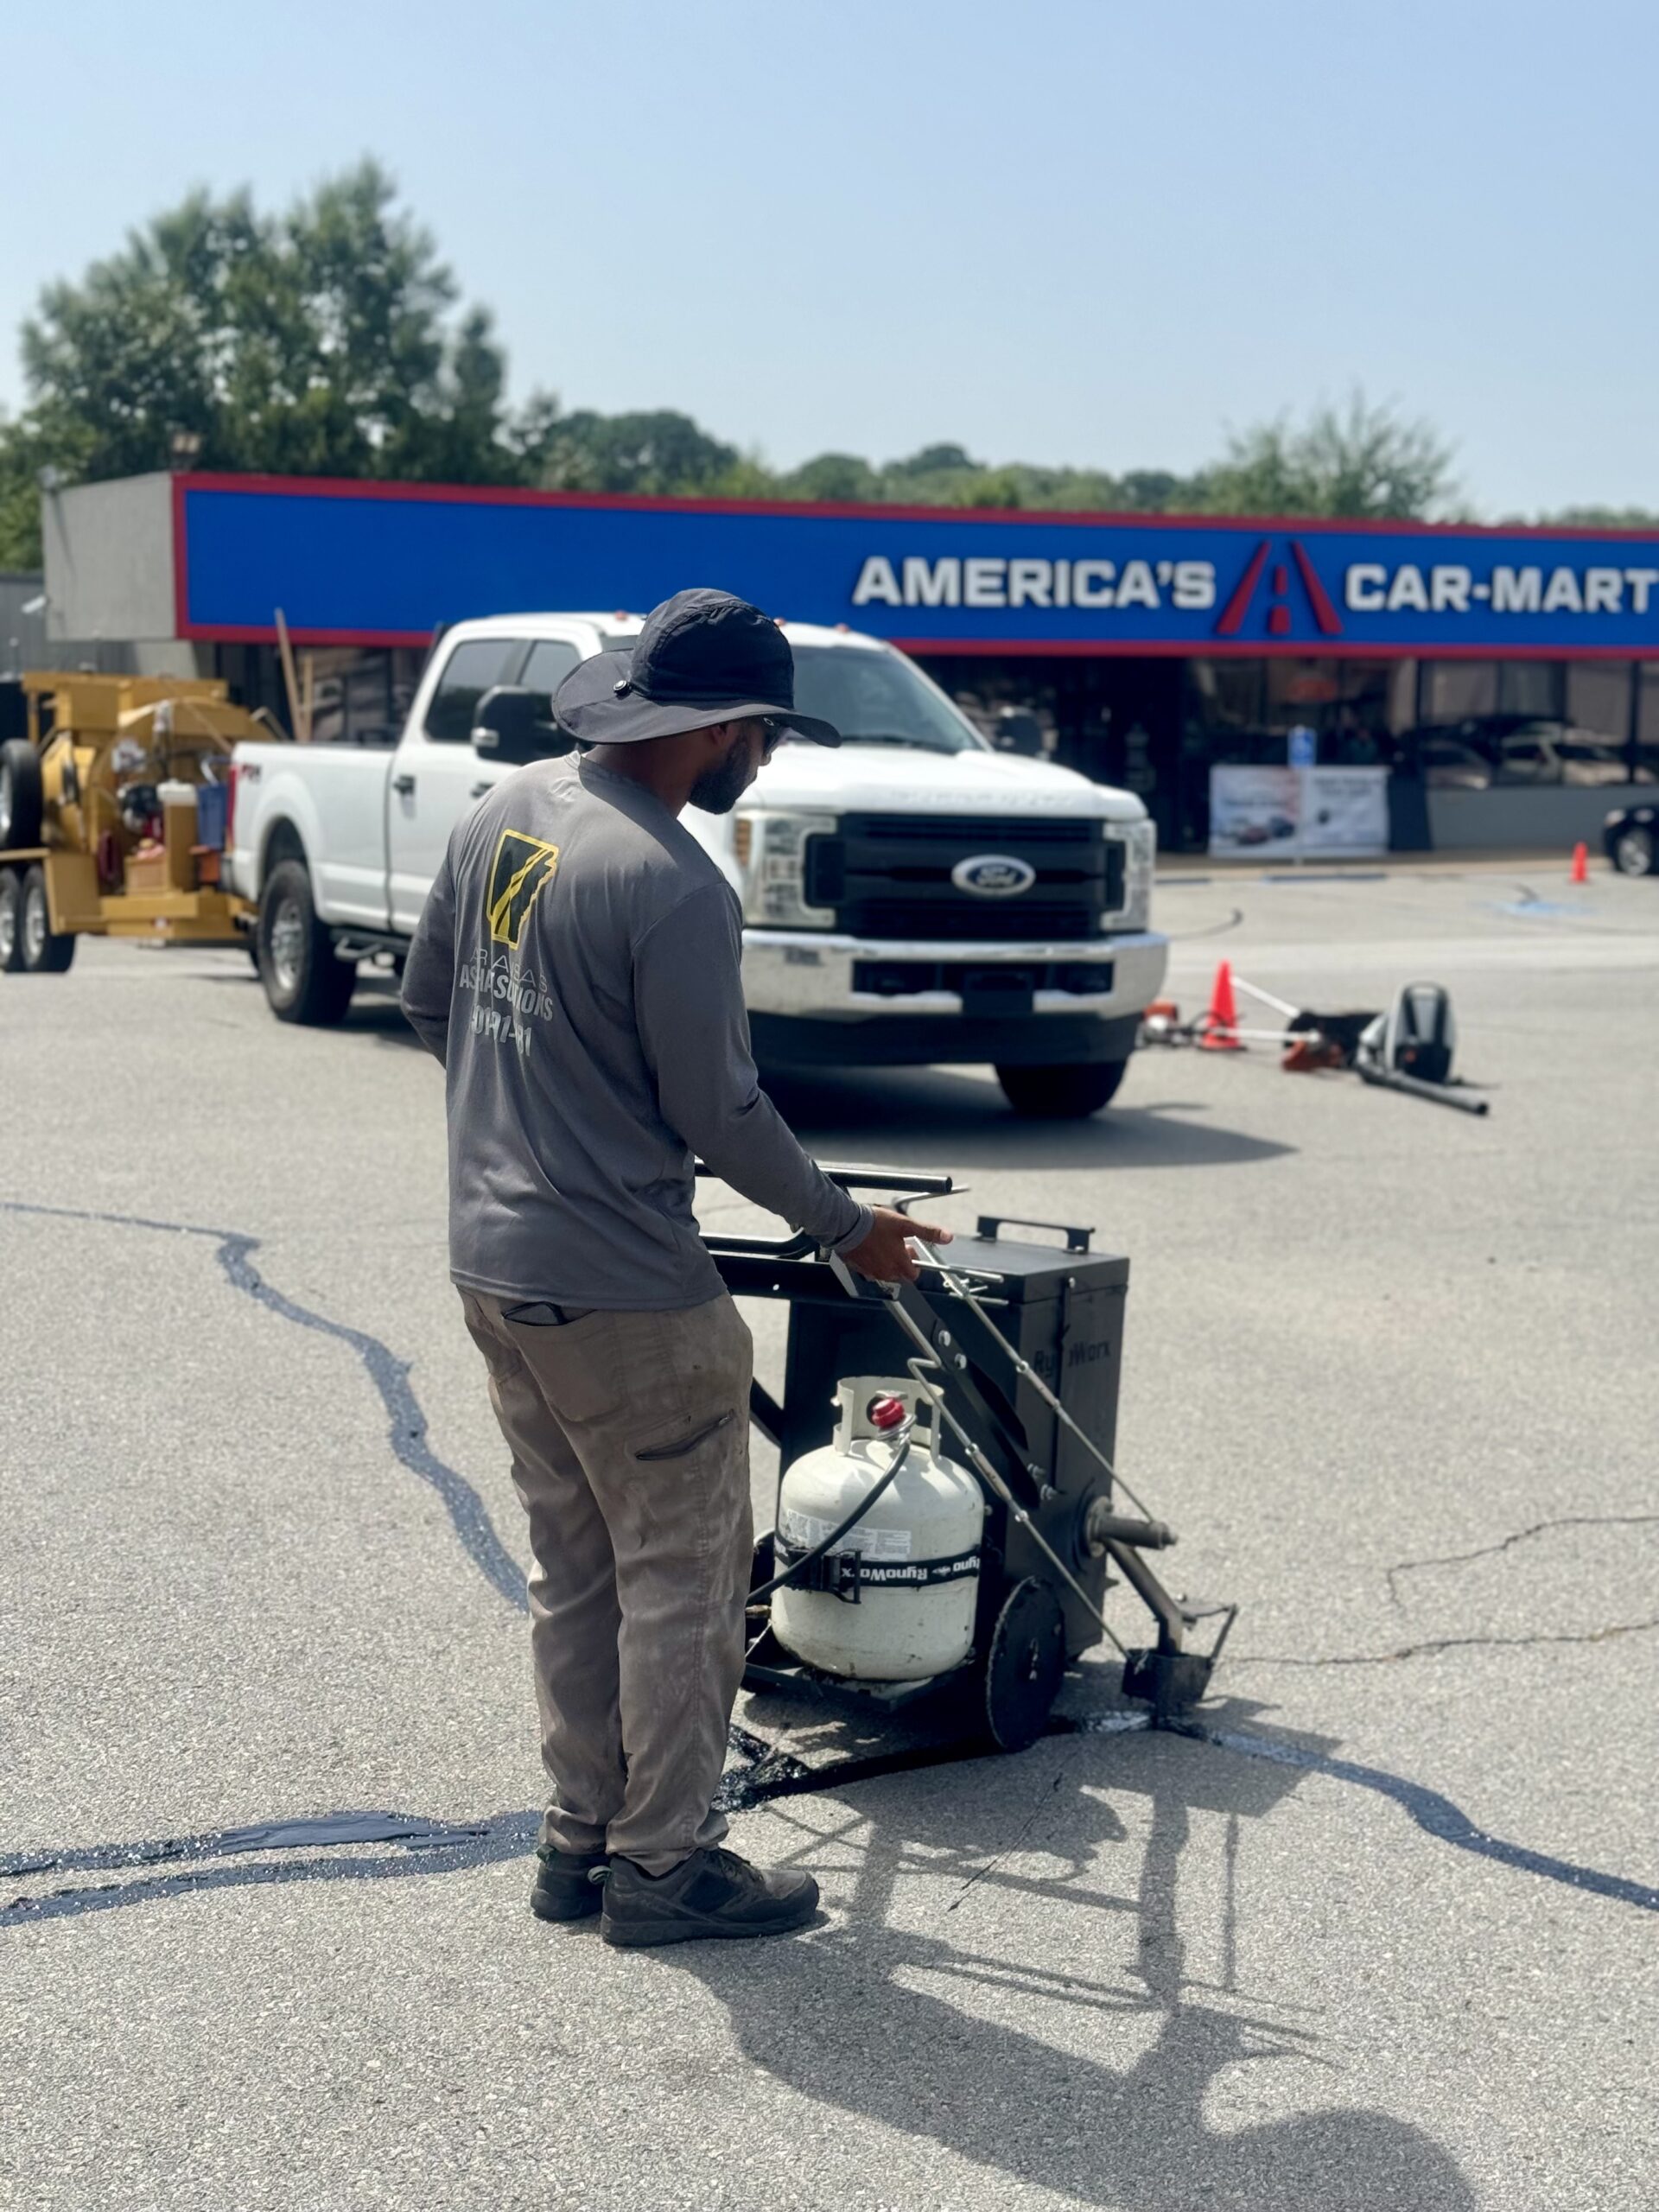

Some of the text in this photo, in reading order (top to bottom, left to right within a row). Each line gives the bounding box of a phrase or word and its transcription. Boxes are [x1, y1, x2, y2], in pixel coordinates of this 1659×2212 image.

[852, 556, 1658, 614] AMERICA'S CAR-MART
[841, 1567, 928, 1581] RynoWox
